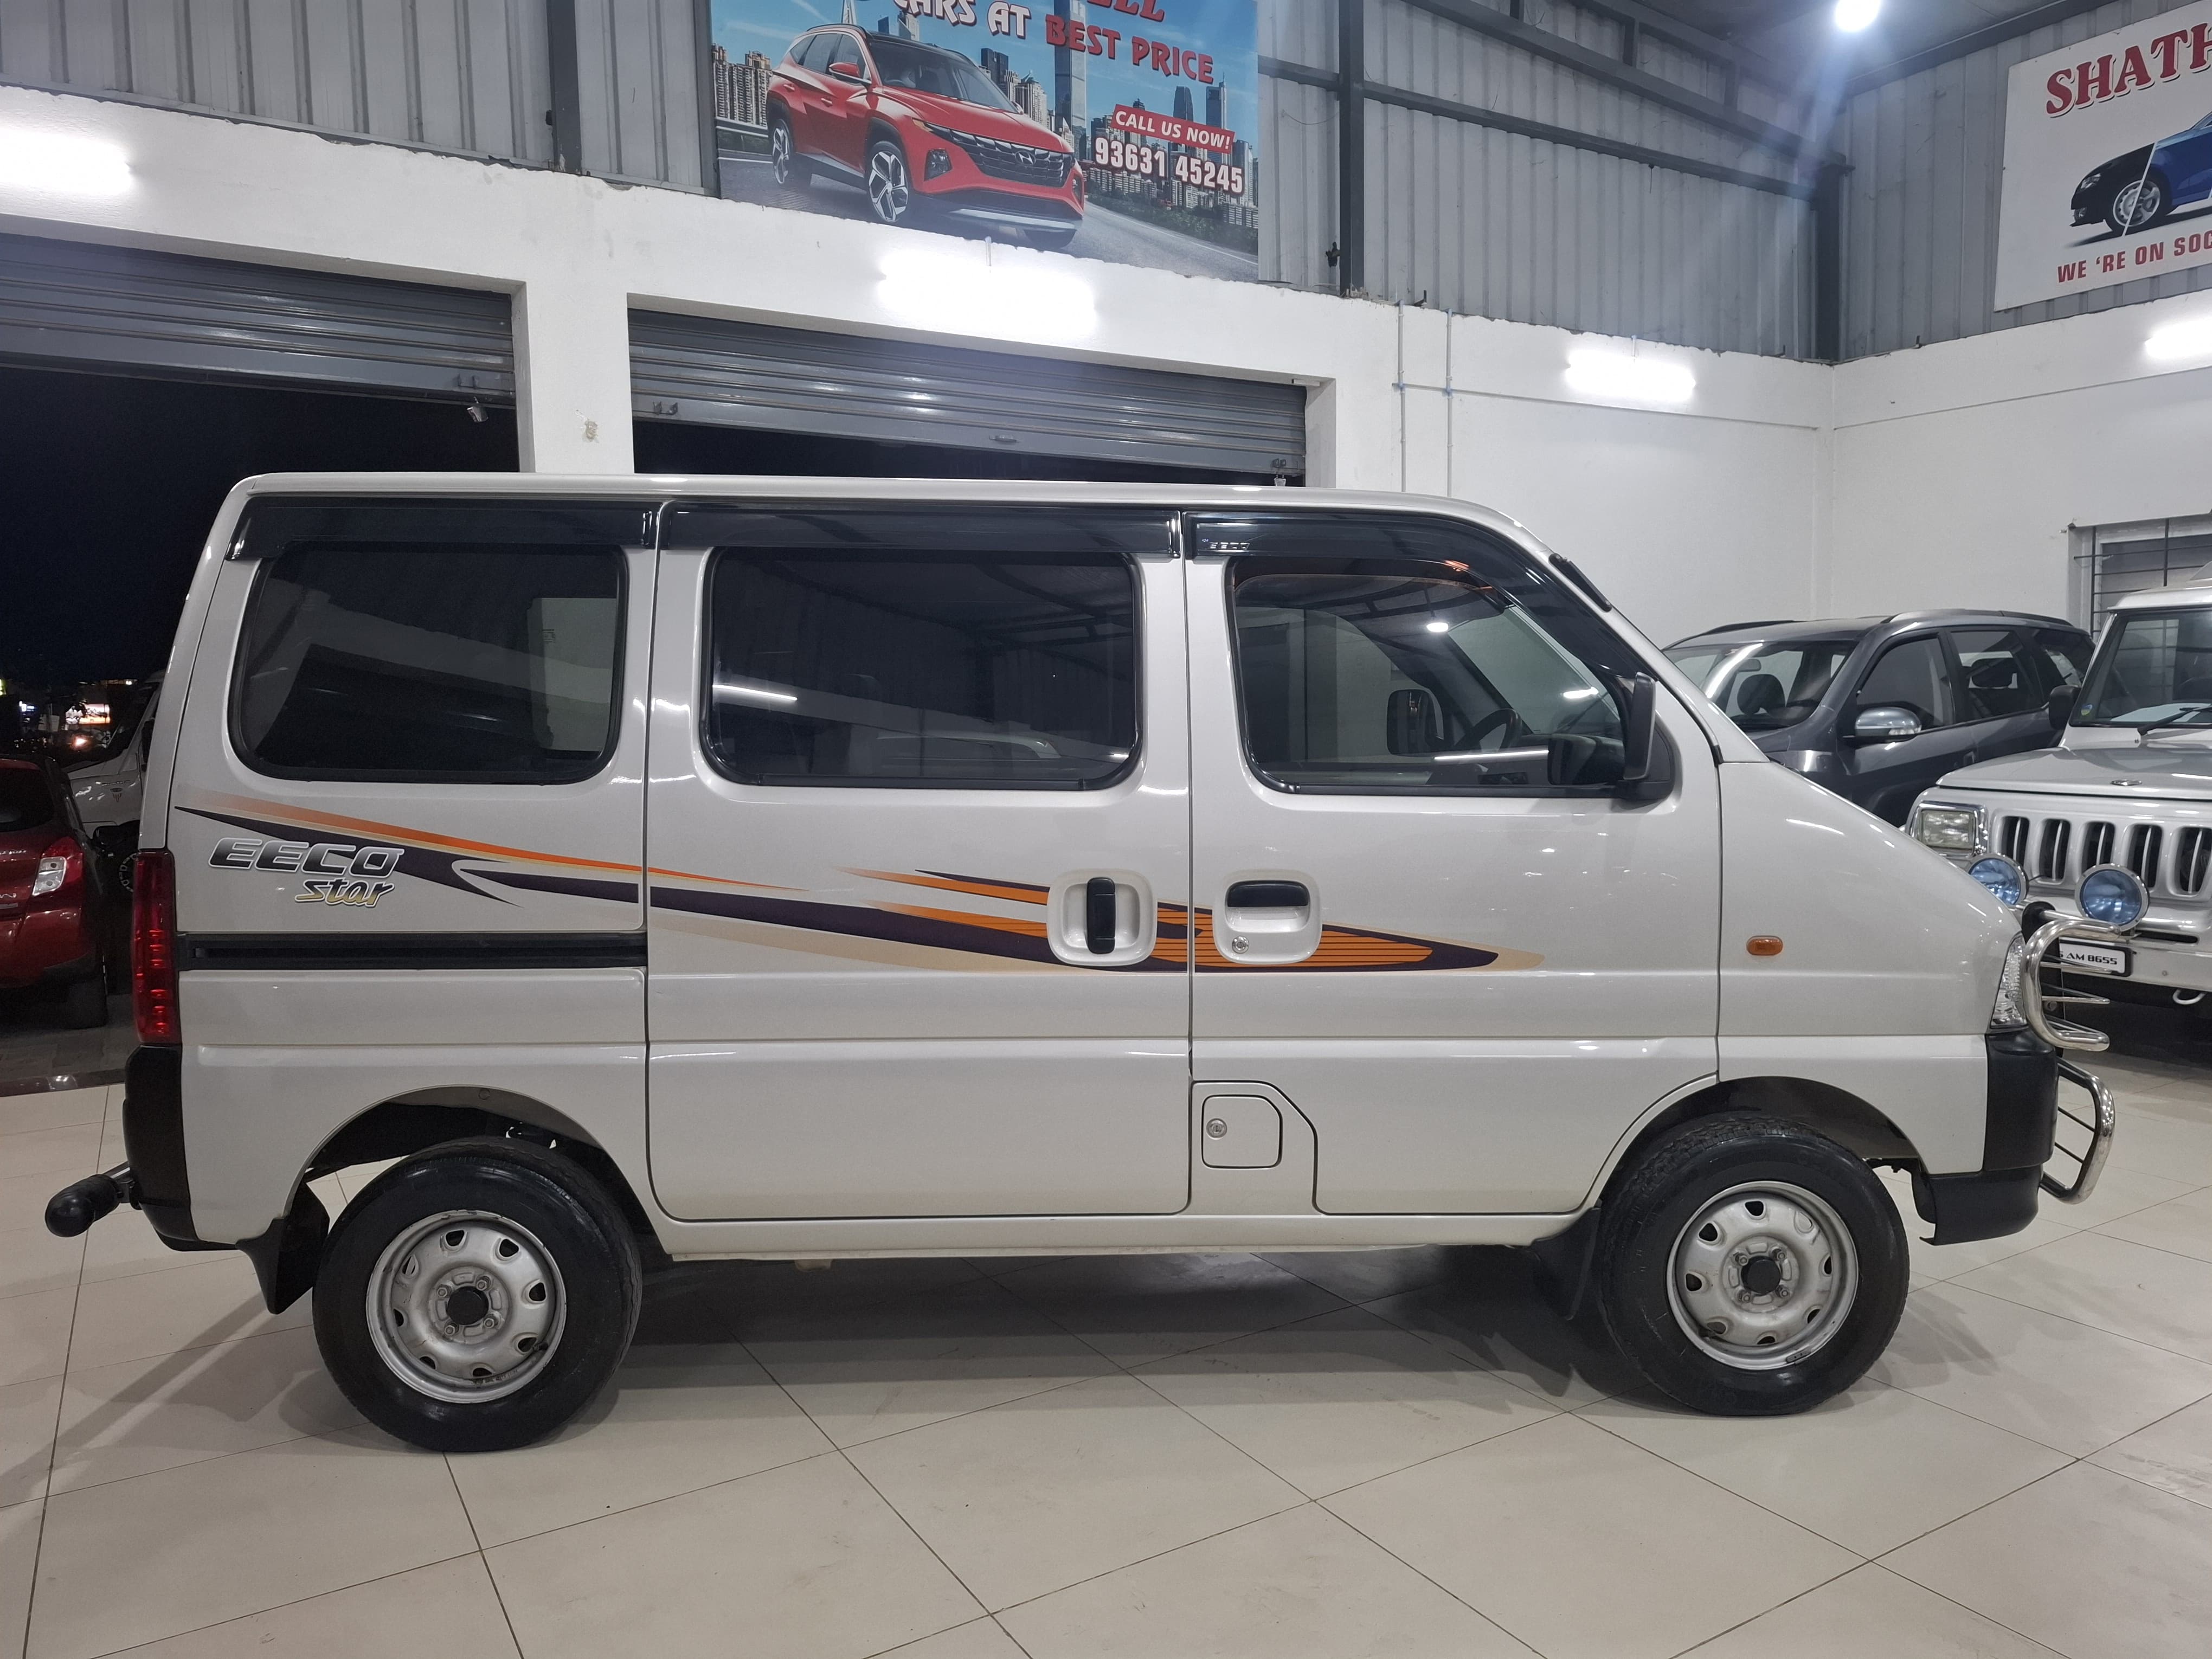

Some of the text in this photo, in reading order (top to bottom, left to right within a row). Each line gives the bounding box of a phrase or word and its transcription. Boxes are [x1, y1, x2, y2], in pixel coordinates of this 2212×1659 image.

[987, 1, 1032, 39] AT
[1045, 14, 1121, 60] BEST
[1132, 36, 1214, 85] PRICE
[1115, 111, 1231, 150] CALL US NOW!
[1095, 137, 1243, 194] 93631 45245
[2057, 260, 2087, 282] WE
[2135, 242, 2164, 265] ON
[208, 837, 405, 879] EECO
[2066, 953, 2085, 961] AM
[2087, 955, 2118, 964] 8655
